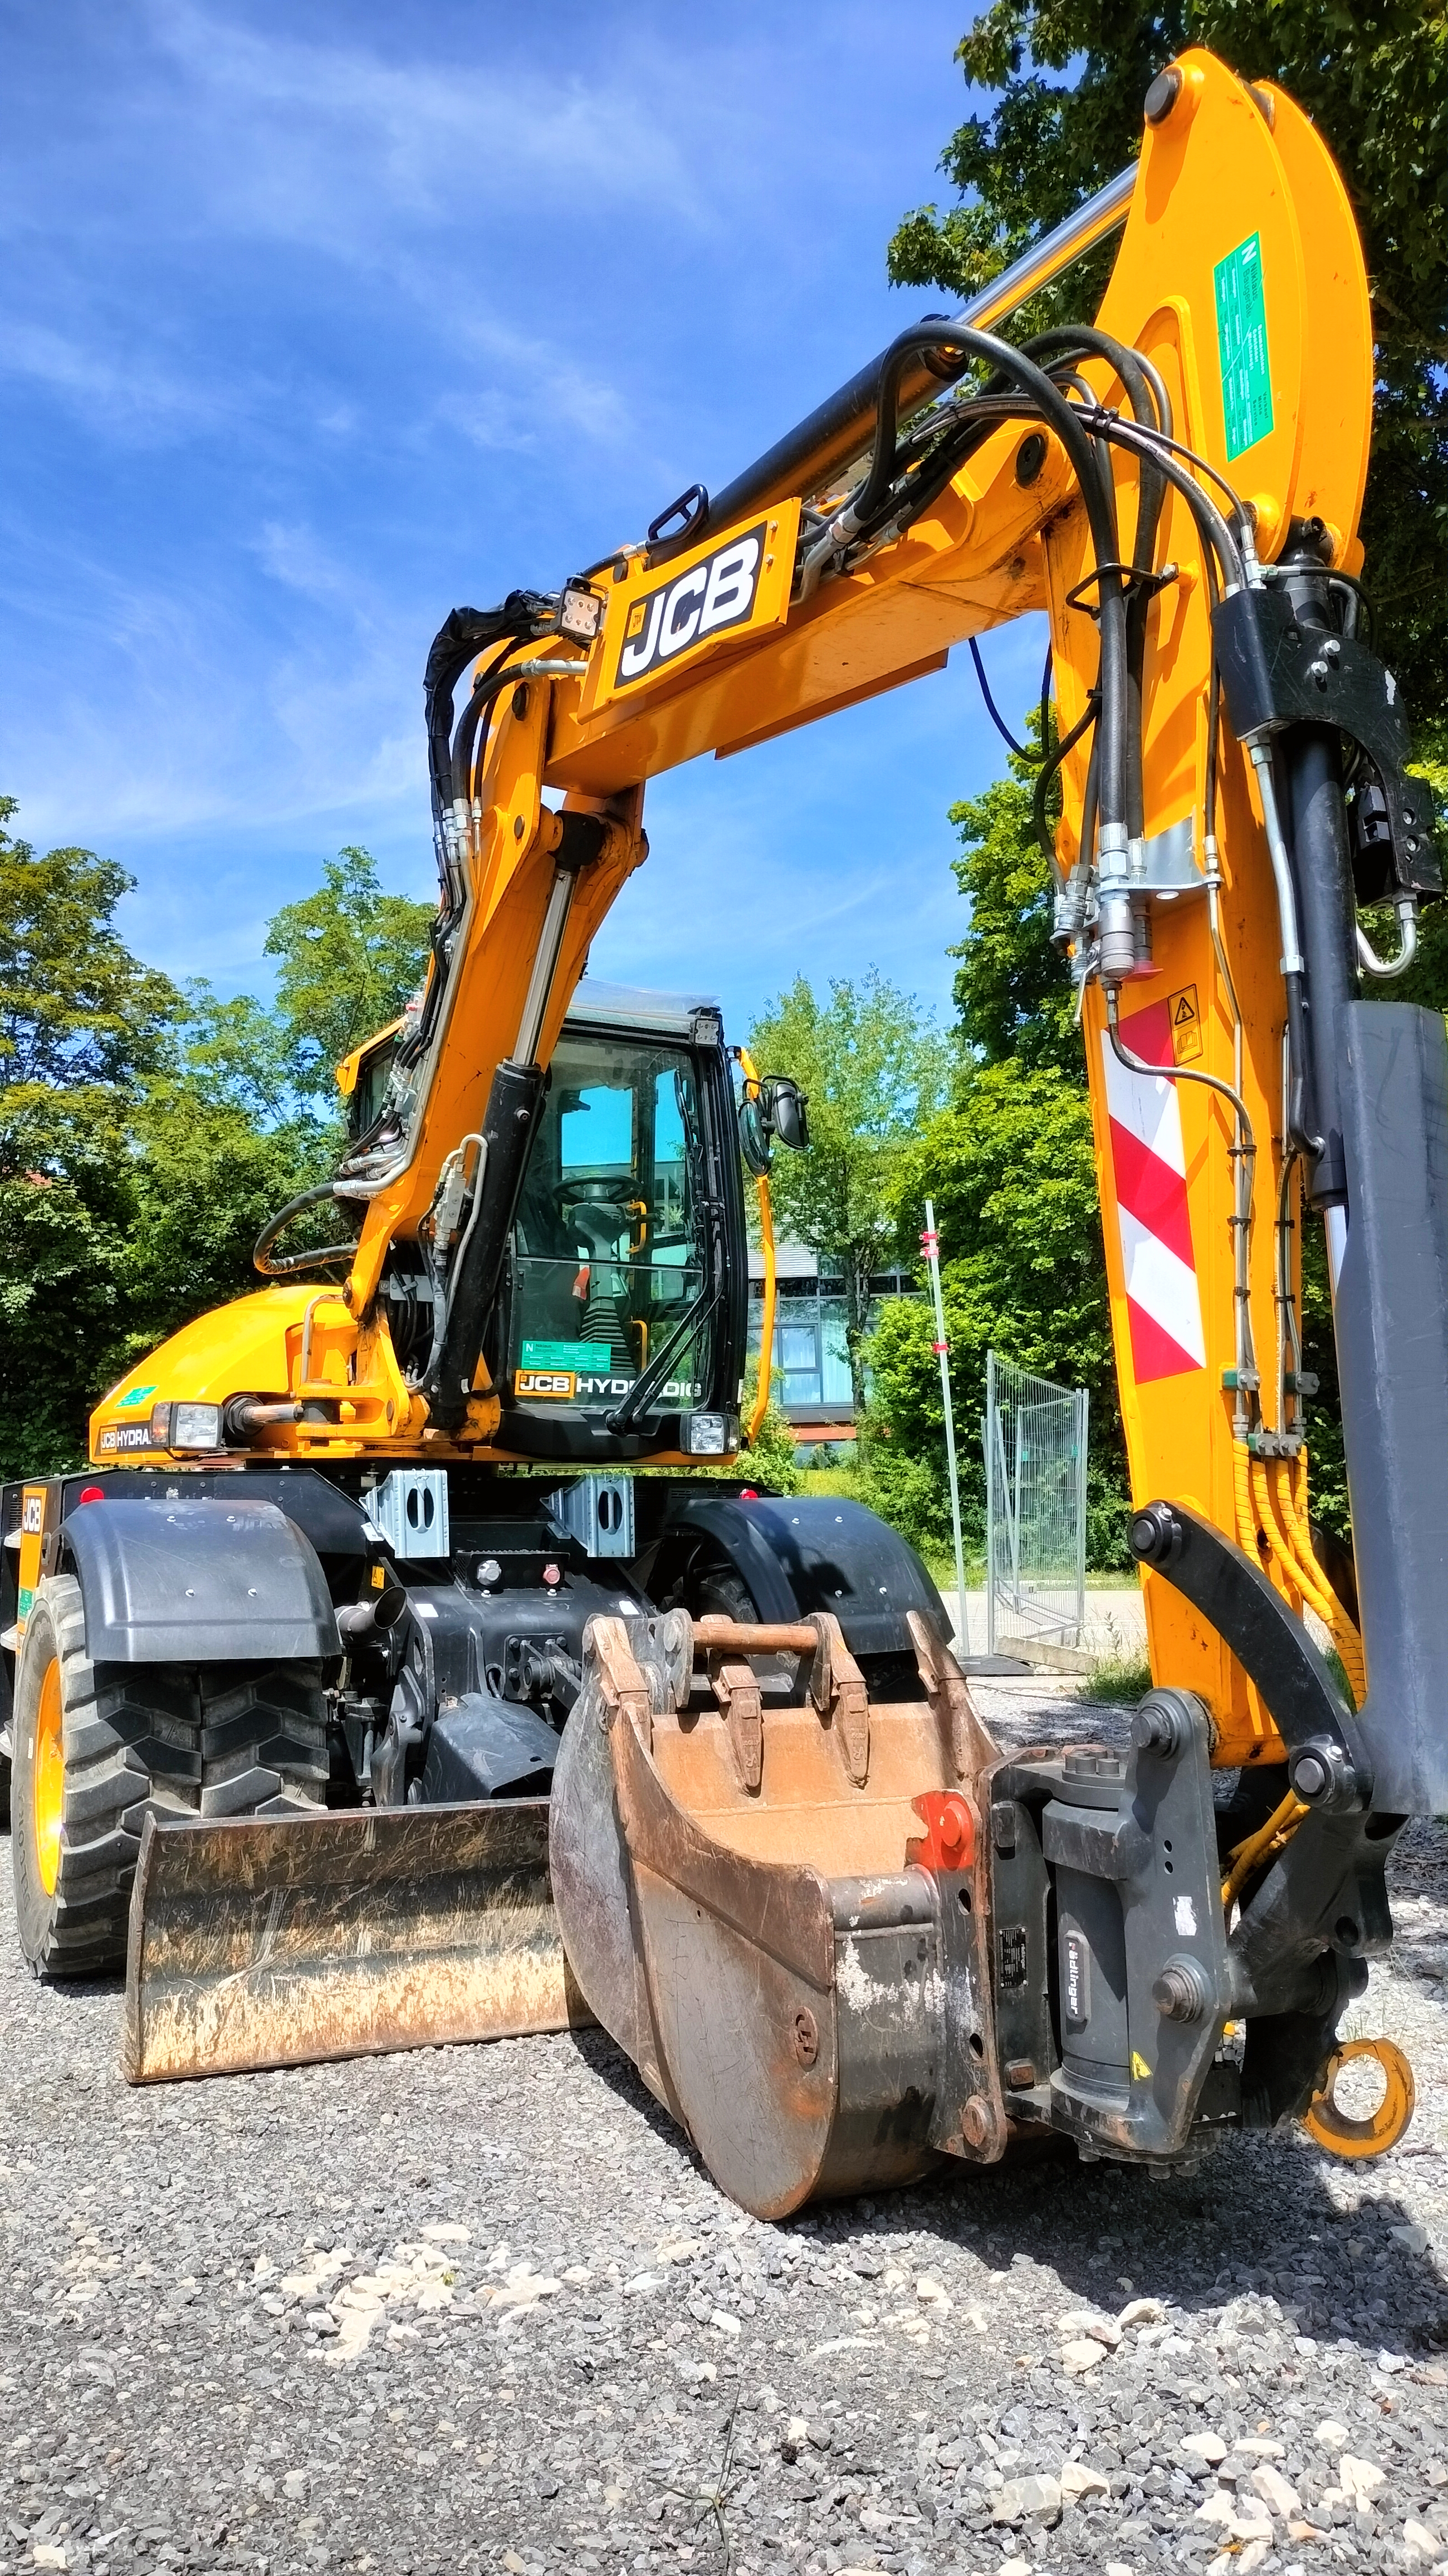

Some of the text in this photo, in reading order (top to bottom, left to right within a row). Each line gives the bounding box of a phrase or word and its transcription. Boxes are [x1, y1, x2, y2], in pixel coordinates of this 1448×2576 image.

[1241, 240, 1257, 266] N
[1241, 267, 1253, 320] Baugeräte
[1250, 261, 1259, 302] Niklaus
[622, 538, 759, 677] JCB
[526, 1343, 534, 1352] N
[520, 1375, 702, 1397] JCB HYDDIG
[101, 1432, 115, 1448] JCB
[24, 1498, 42, 1532] JCB
[1068, 1942, 1079, 2014] rädlinger
